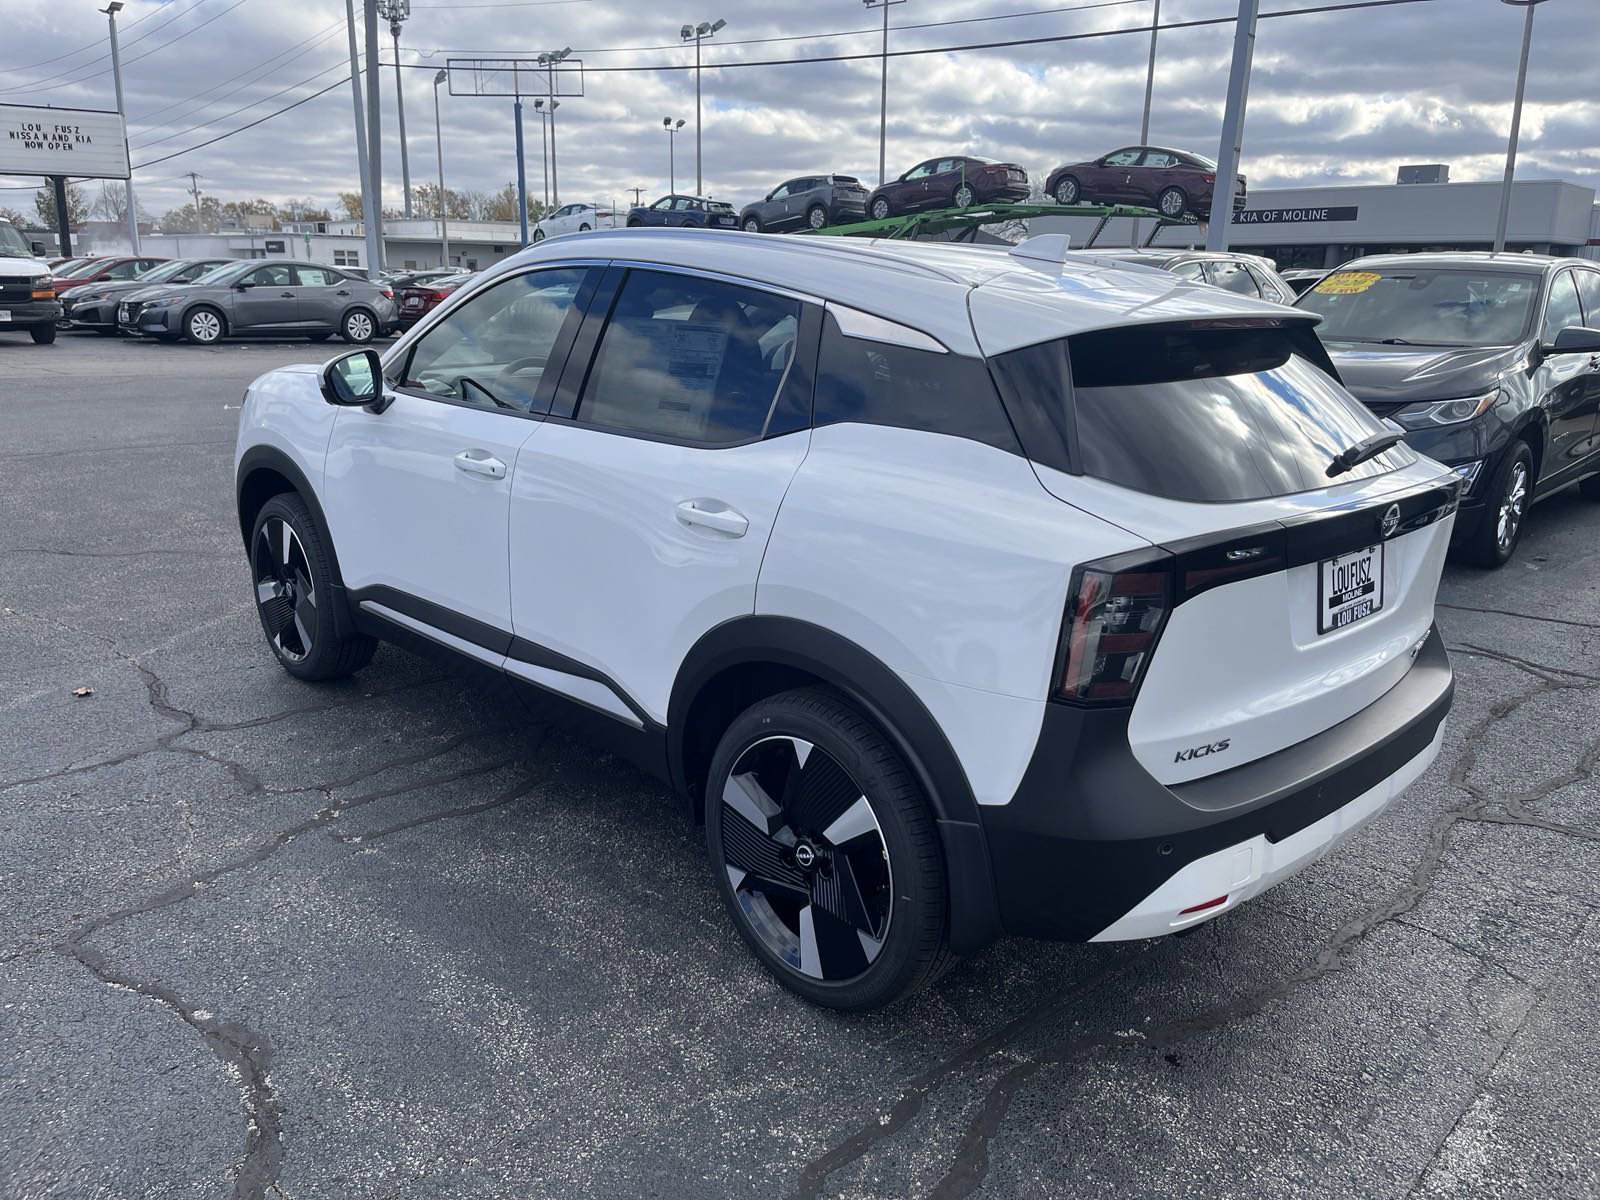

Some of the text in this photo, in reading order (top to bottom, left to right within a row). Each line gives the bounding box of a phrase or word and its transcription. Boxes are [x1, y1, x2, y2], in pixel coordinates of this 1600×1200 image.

[22, 123, 80, 134] LOU FUSZ
[9, 132, 48, 141] NISSAN
[52, 134, 69, 142] AND
[24, 141, 73, 151] NOW OPEN
[1239, 212, 1258, 222] KIA
[1262, 211, 1278, 221] OF
[1282, 209, 1328, 221] MOLINE
[1332, 556, 1371, 595] LOU FUSZ
[1342, 587, 1363, 602] MOLINE
[1337, 609, 1352, 627] LOU
[1353, 601, 1371, 621] FUSZ
[1174, 738, 1231, 763] KICKS
